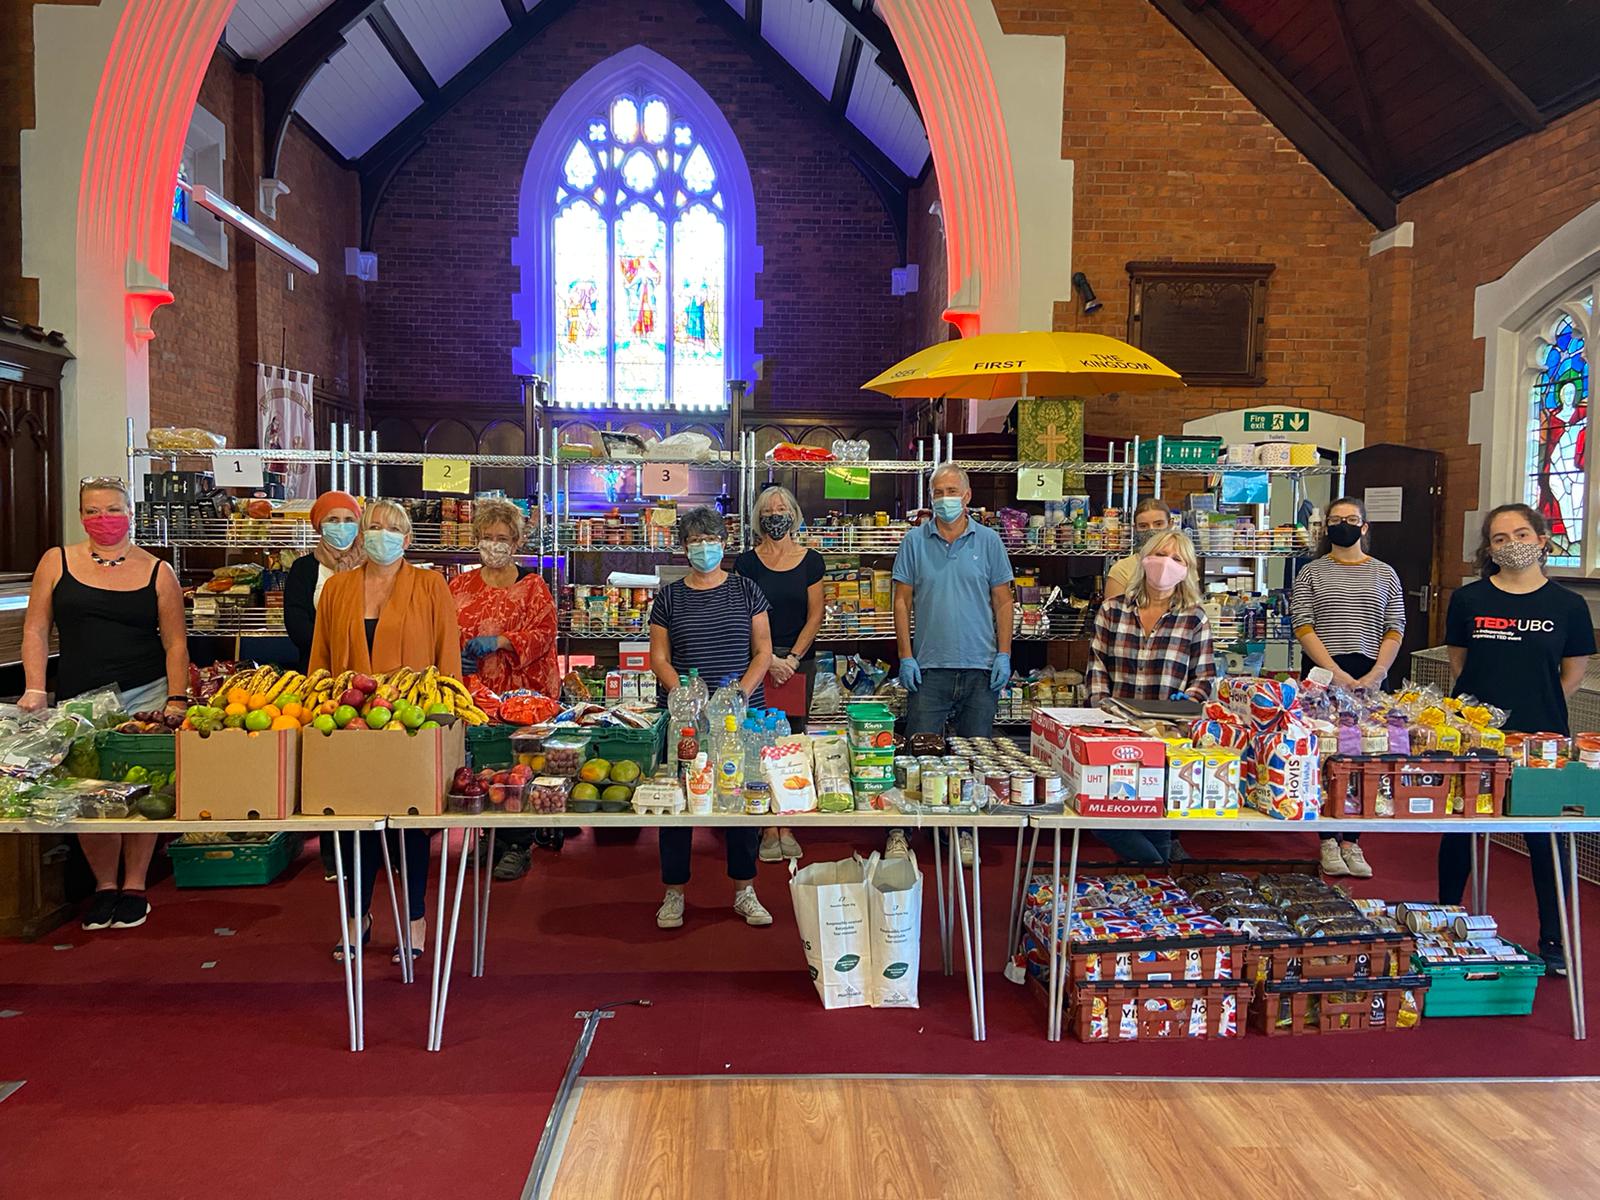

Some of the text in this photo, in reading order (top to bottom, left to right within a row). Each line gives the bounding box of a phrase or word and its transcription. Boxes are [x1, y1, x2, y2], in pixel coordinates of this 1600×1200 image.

[1091, 353, 1120, 361] THE
[974, 360, 1027, 370] FIRST
[1080, 360, 1152, 370] KINGDOM
[1250, 414, 1266, 423] Fire
[1250, 422, 1265, 430] exit
[233, 460, 243, 473] 1
[443, 465, 452, 478] 2
[661, 469, 671, 482] 3
[843, 472, 853, 486] 4
[1036, 474, 1046, 488] 5
[1112, 768, 1135, 777] MILK
[1087, 774, 1103, 784] UHT
[1288, 759, 1300, 799] HOVIS
[1088, 804, 1158, 814] MLEKOVITA
